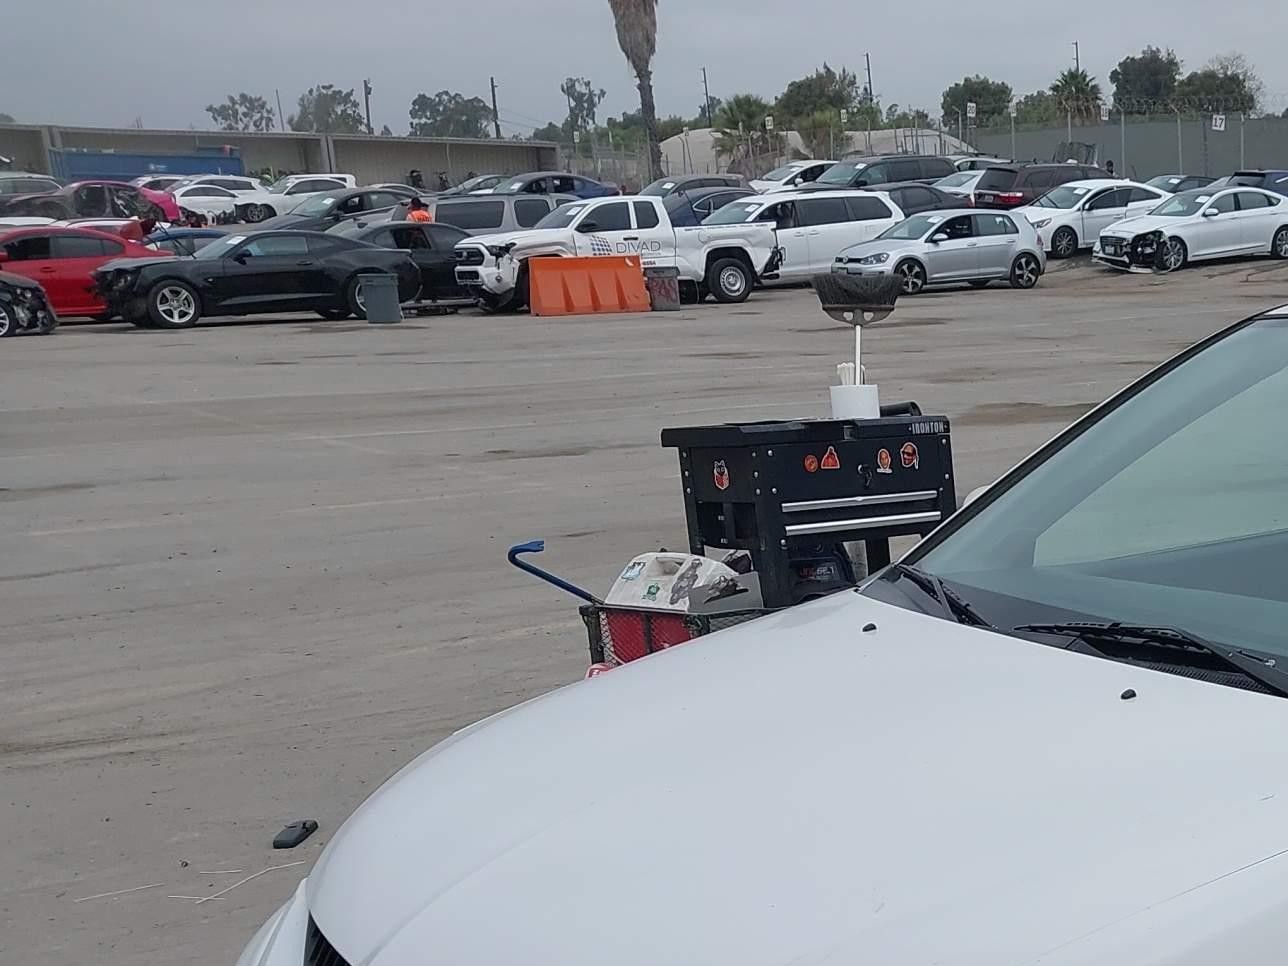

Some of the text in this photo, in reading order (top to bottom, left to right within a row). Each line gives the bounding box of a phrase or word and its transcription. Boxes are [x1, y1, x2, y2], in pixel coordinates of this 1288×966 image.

[1213, 117, 1225, 129] 17
[615, 240, 661, 254] DIVAD
[912, 421, 945, 435] IRONTON
